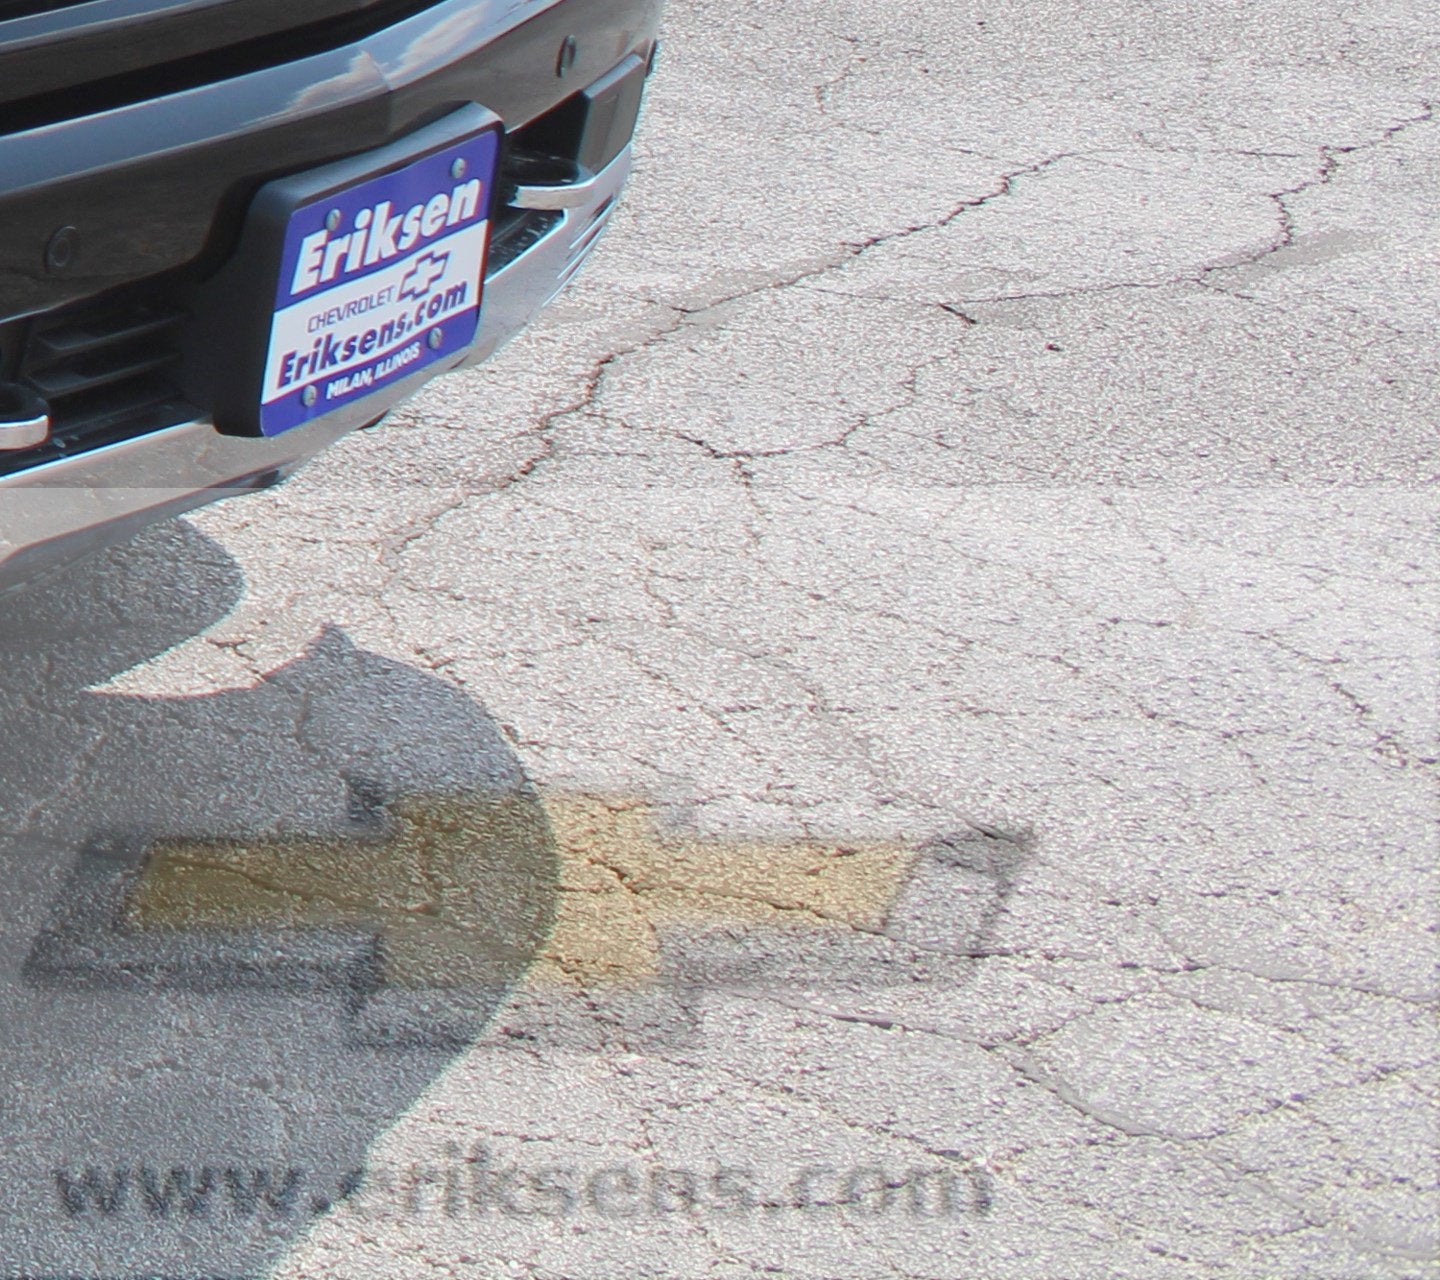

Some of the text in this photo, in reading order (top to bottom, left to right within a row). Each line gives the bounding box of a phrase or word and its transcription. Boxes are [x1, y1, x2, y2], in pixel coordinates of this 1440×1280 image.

[289, 176, 482, 296] Eriksen
[276, 280, 467, 390] Eriksens.com
[307, 285, 395, 334] CHEVROLET
[326, 341, 421, 400] MILAN, ILLINOIS
